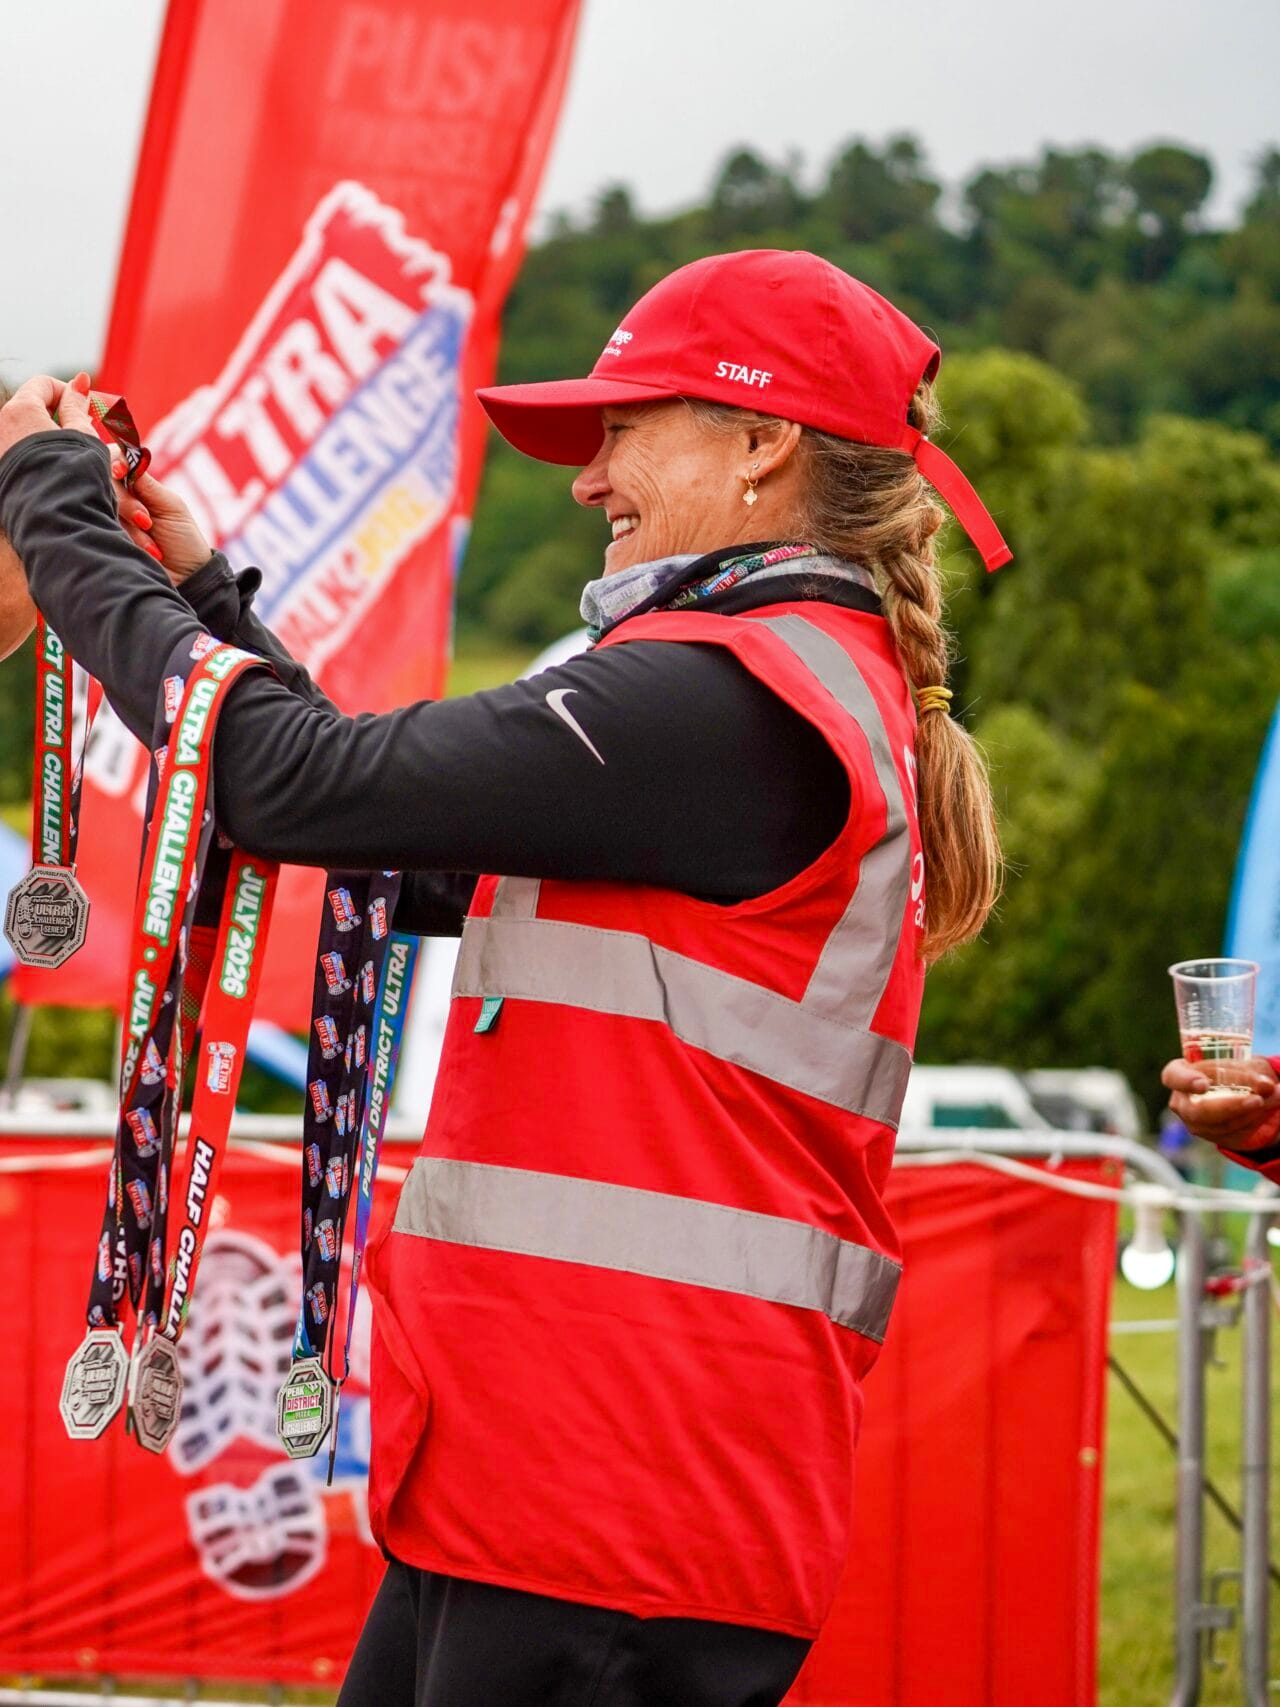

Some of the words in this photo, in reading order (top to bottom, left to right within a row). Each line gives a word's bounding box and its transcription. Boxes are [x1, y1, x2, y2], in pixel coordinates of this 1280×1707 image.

[715, 361, 772, 388] STAFF
[228, 335, 453, 600] HALLENGE
[45, 673, 63, 746] ULTRA
[179, 680, 219, 763] ULTRA
[145, 772, 196, 940] CHALLENGE
[35, 903, 69, 916] ULTRA
[233, 867, 262, 932] JULY
[331, 892, 346, 923] ULTRA
[222, 929, 253, 996] 2026
[324, 957, 339, 987] ULTRA
[382, 943, 410, 1016] ULTRA
[131, 972, 154, 1039] JULY
[317, 1020, 332, 1051] ULTRA
[220, 1056, 231, 1091] ULTRA
[370, 1018, 395, 1129] DISTRICT
[133, 1112, 147, 1147] ULTRA
[187, 1139, 215, 1226] HALF
[363, 1133, 377, 1198] PEAK
[287, 1387, 305, 1398] PEAK
[287, 1395, 320, 1411] DISTRICT
[287, 1421, 318, 1436] CHALLENGE
